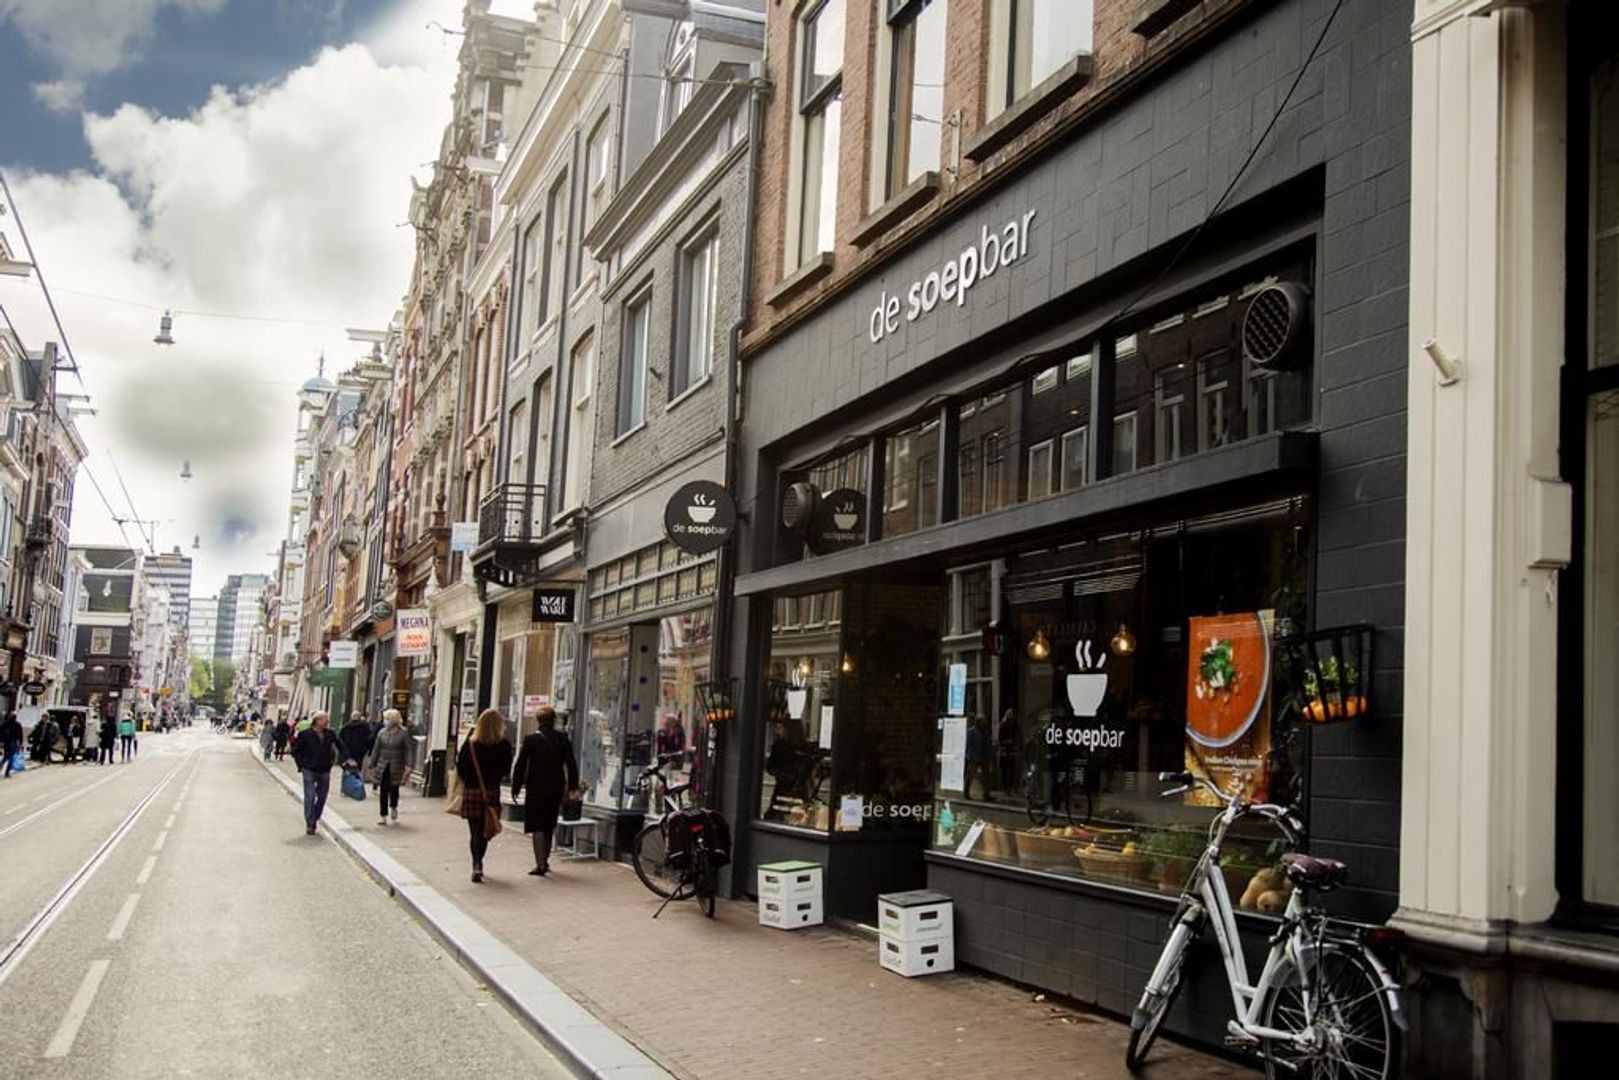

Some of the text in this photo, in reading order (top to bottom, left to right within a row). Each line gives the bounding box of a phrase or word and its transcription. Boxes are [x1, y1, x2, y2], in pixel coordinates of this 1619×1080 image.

[869, 209, 1036, 342] de soepbar
[673, 523, 727, 536] de soepbar
[1045, 723, 1125, 752] de soepbar
[861, 801, 884, 817] de
